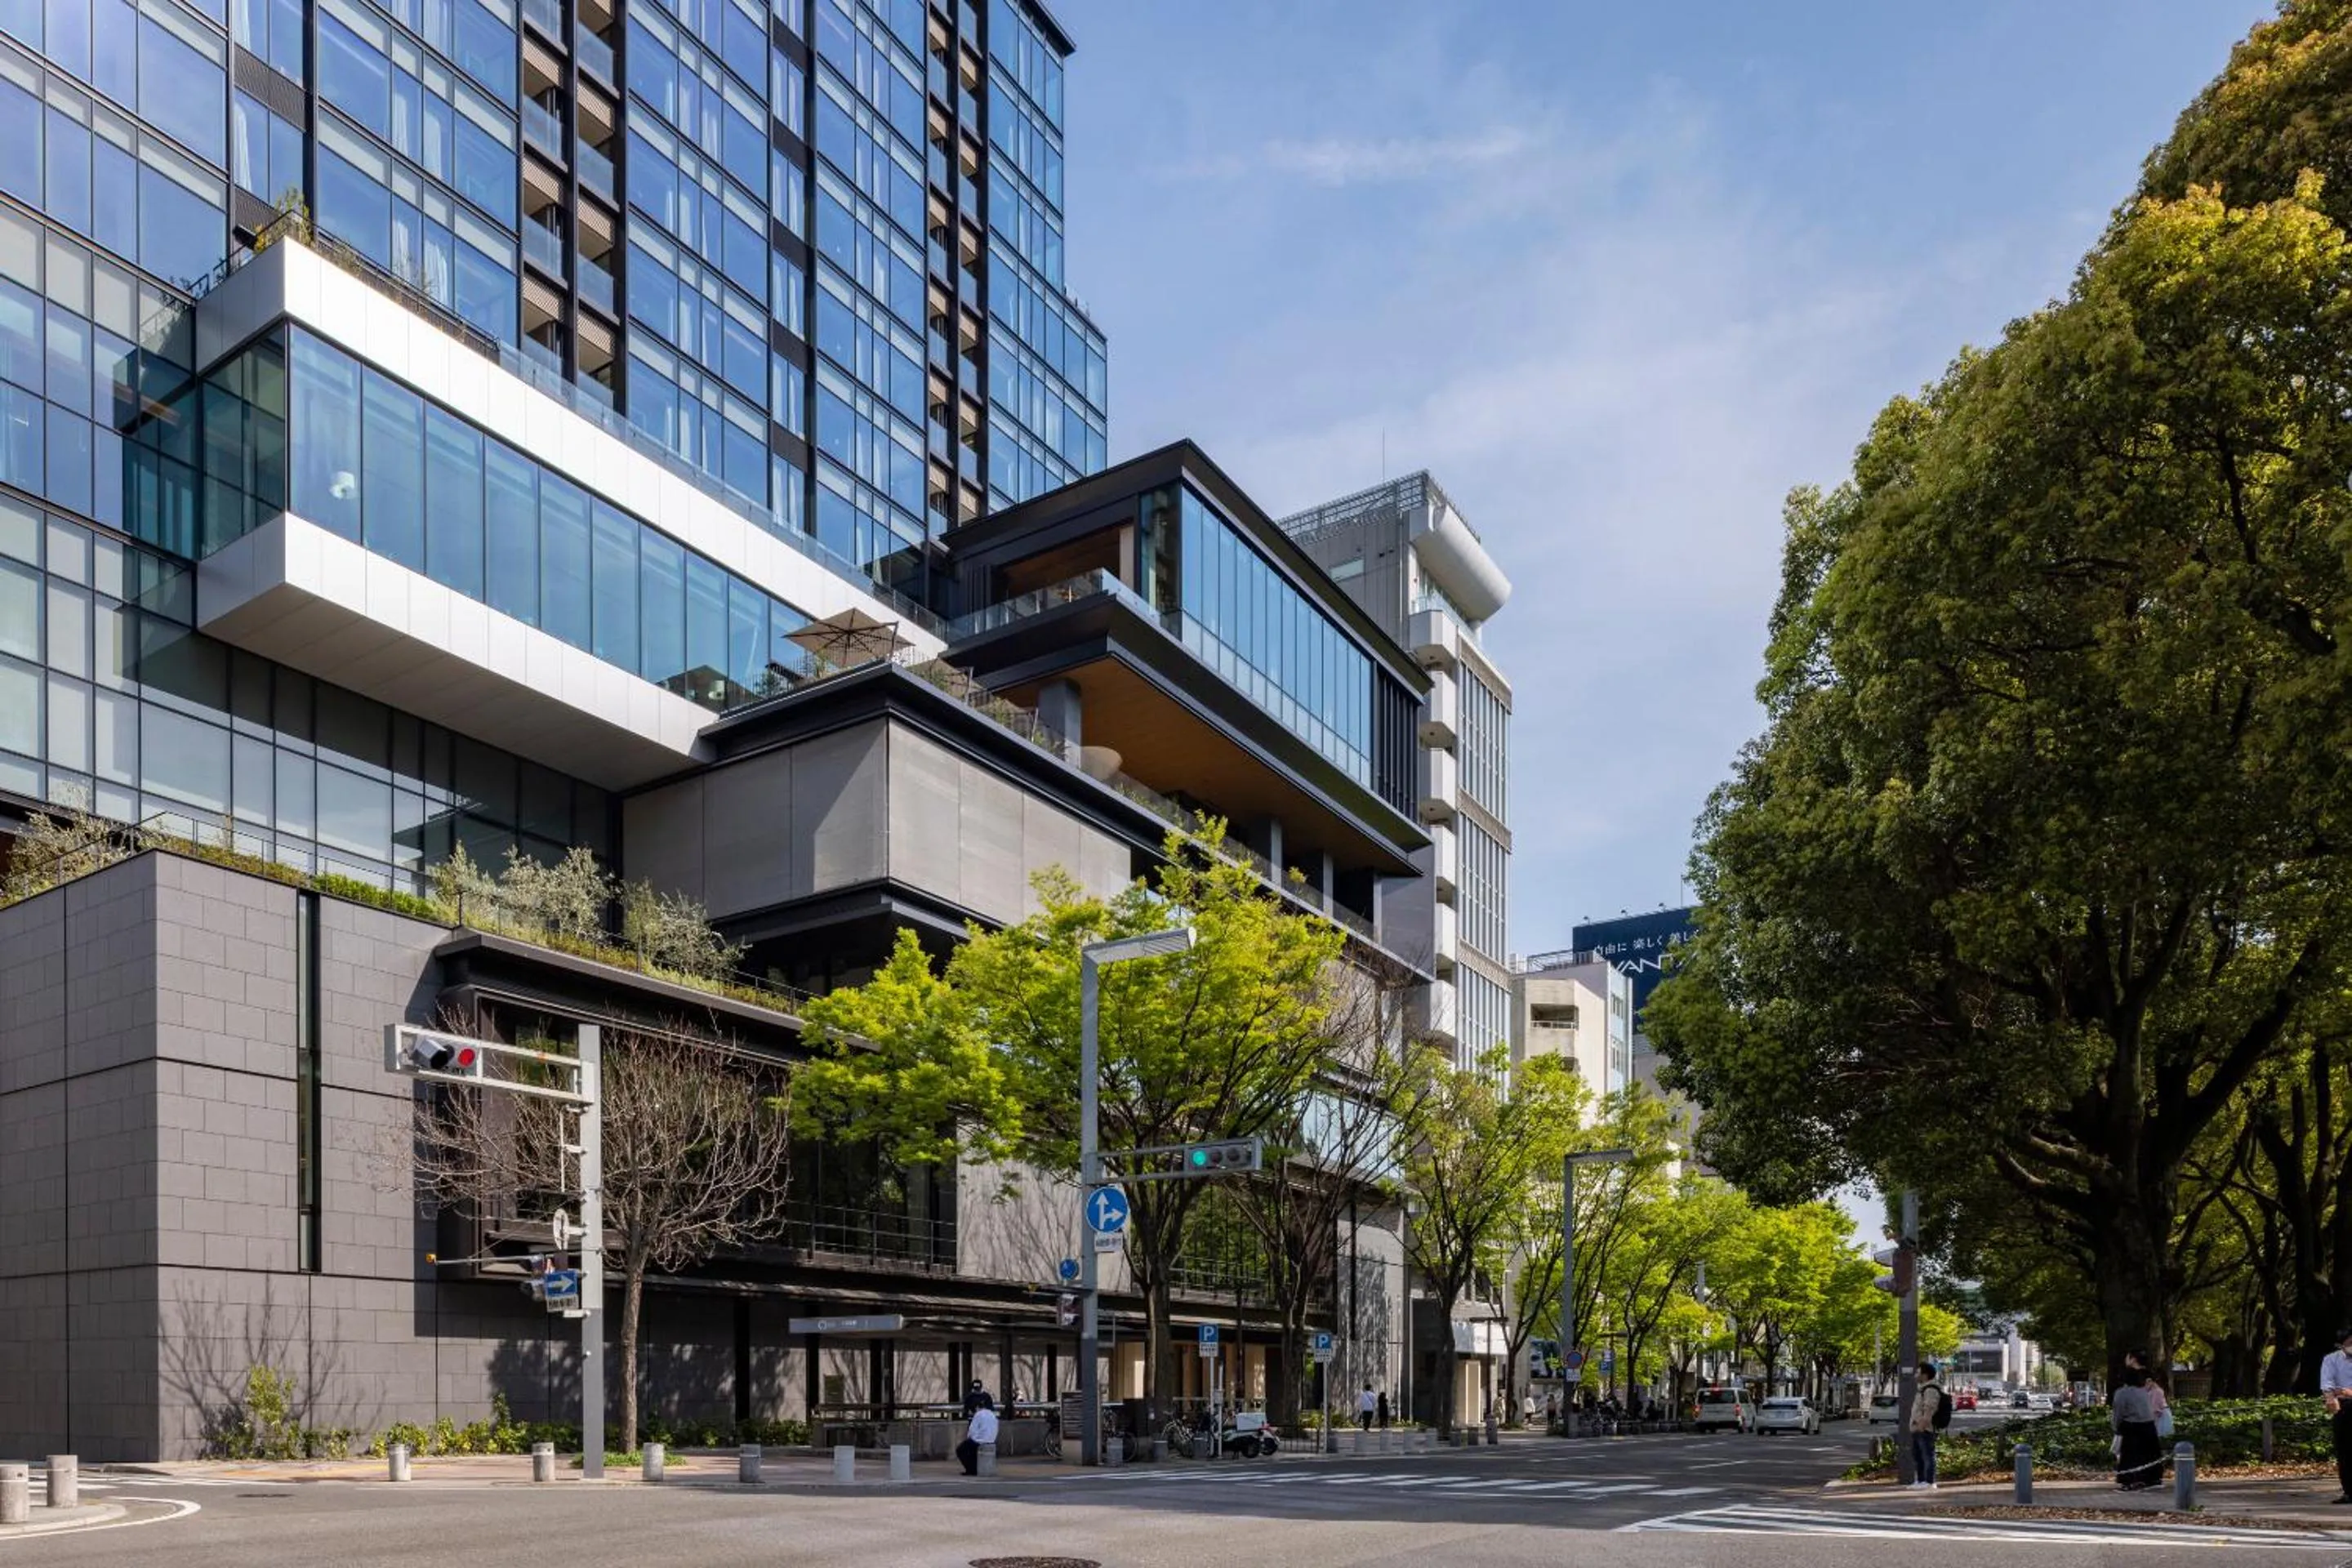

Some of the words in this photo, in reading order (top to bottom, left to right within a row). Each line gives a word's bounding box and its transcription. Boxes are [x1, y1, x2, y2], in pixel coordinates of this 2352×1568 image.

[1633, 935, 1663, 949] 楽しく
[1204, 1325, 1214, 1341] P
[1318, 1333, 1329, 1348] P
